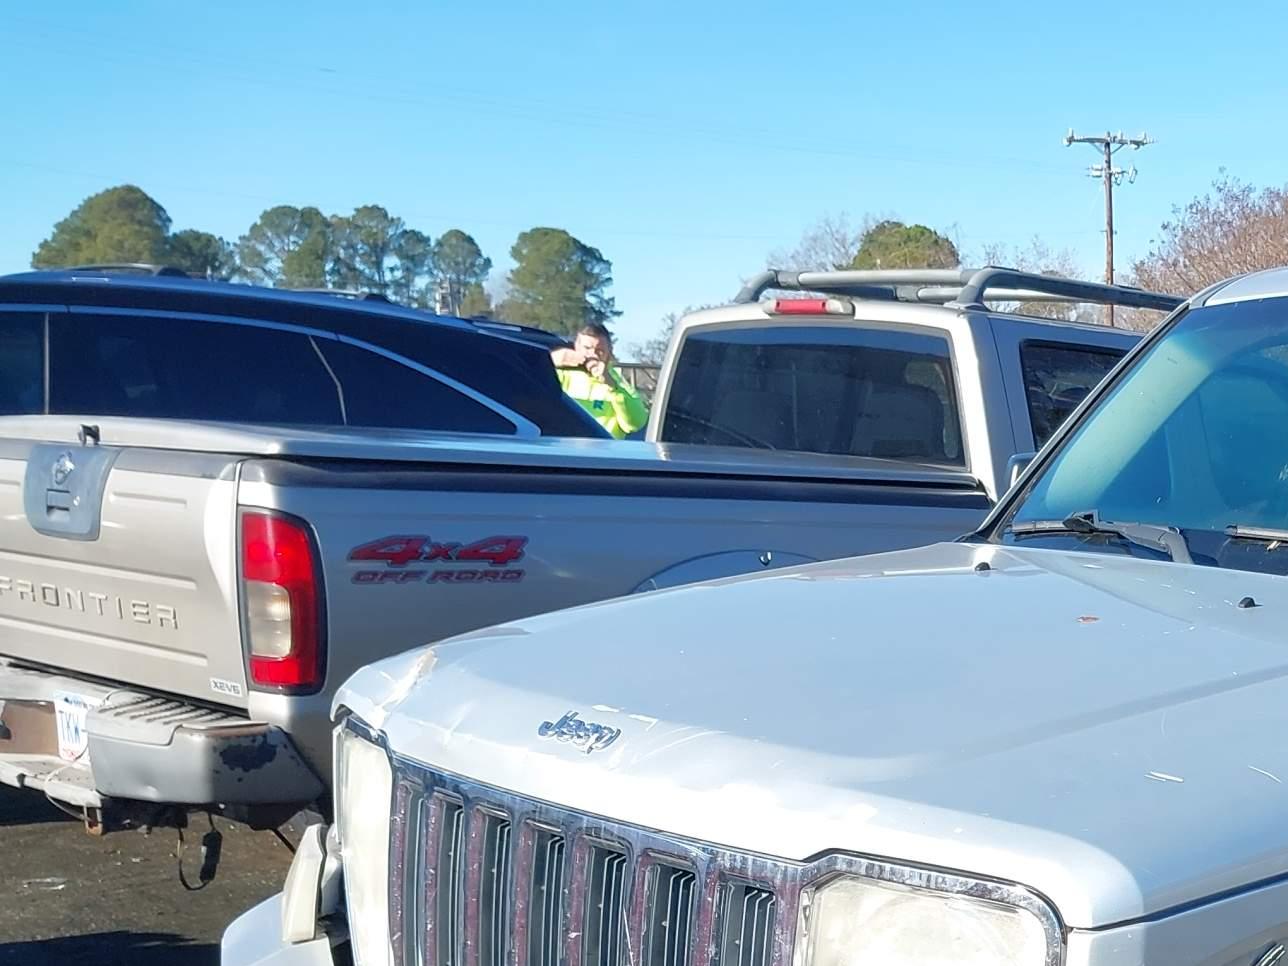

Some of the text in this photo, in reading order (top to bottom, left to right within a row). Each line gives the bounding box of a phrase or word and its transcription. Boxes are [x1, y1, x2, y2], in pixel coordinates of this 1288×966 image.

[351, 569, 526, 585] OFF ROAD
[0, 575, 179, 630] FRONTIER
[537, 709, 622, 756] Jeep
